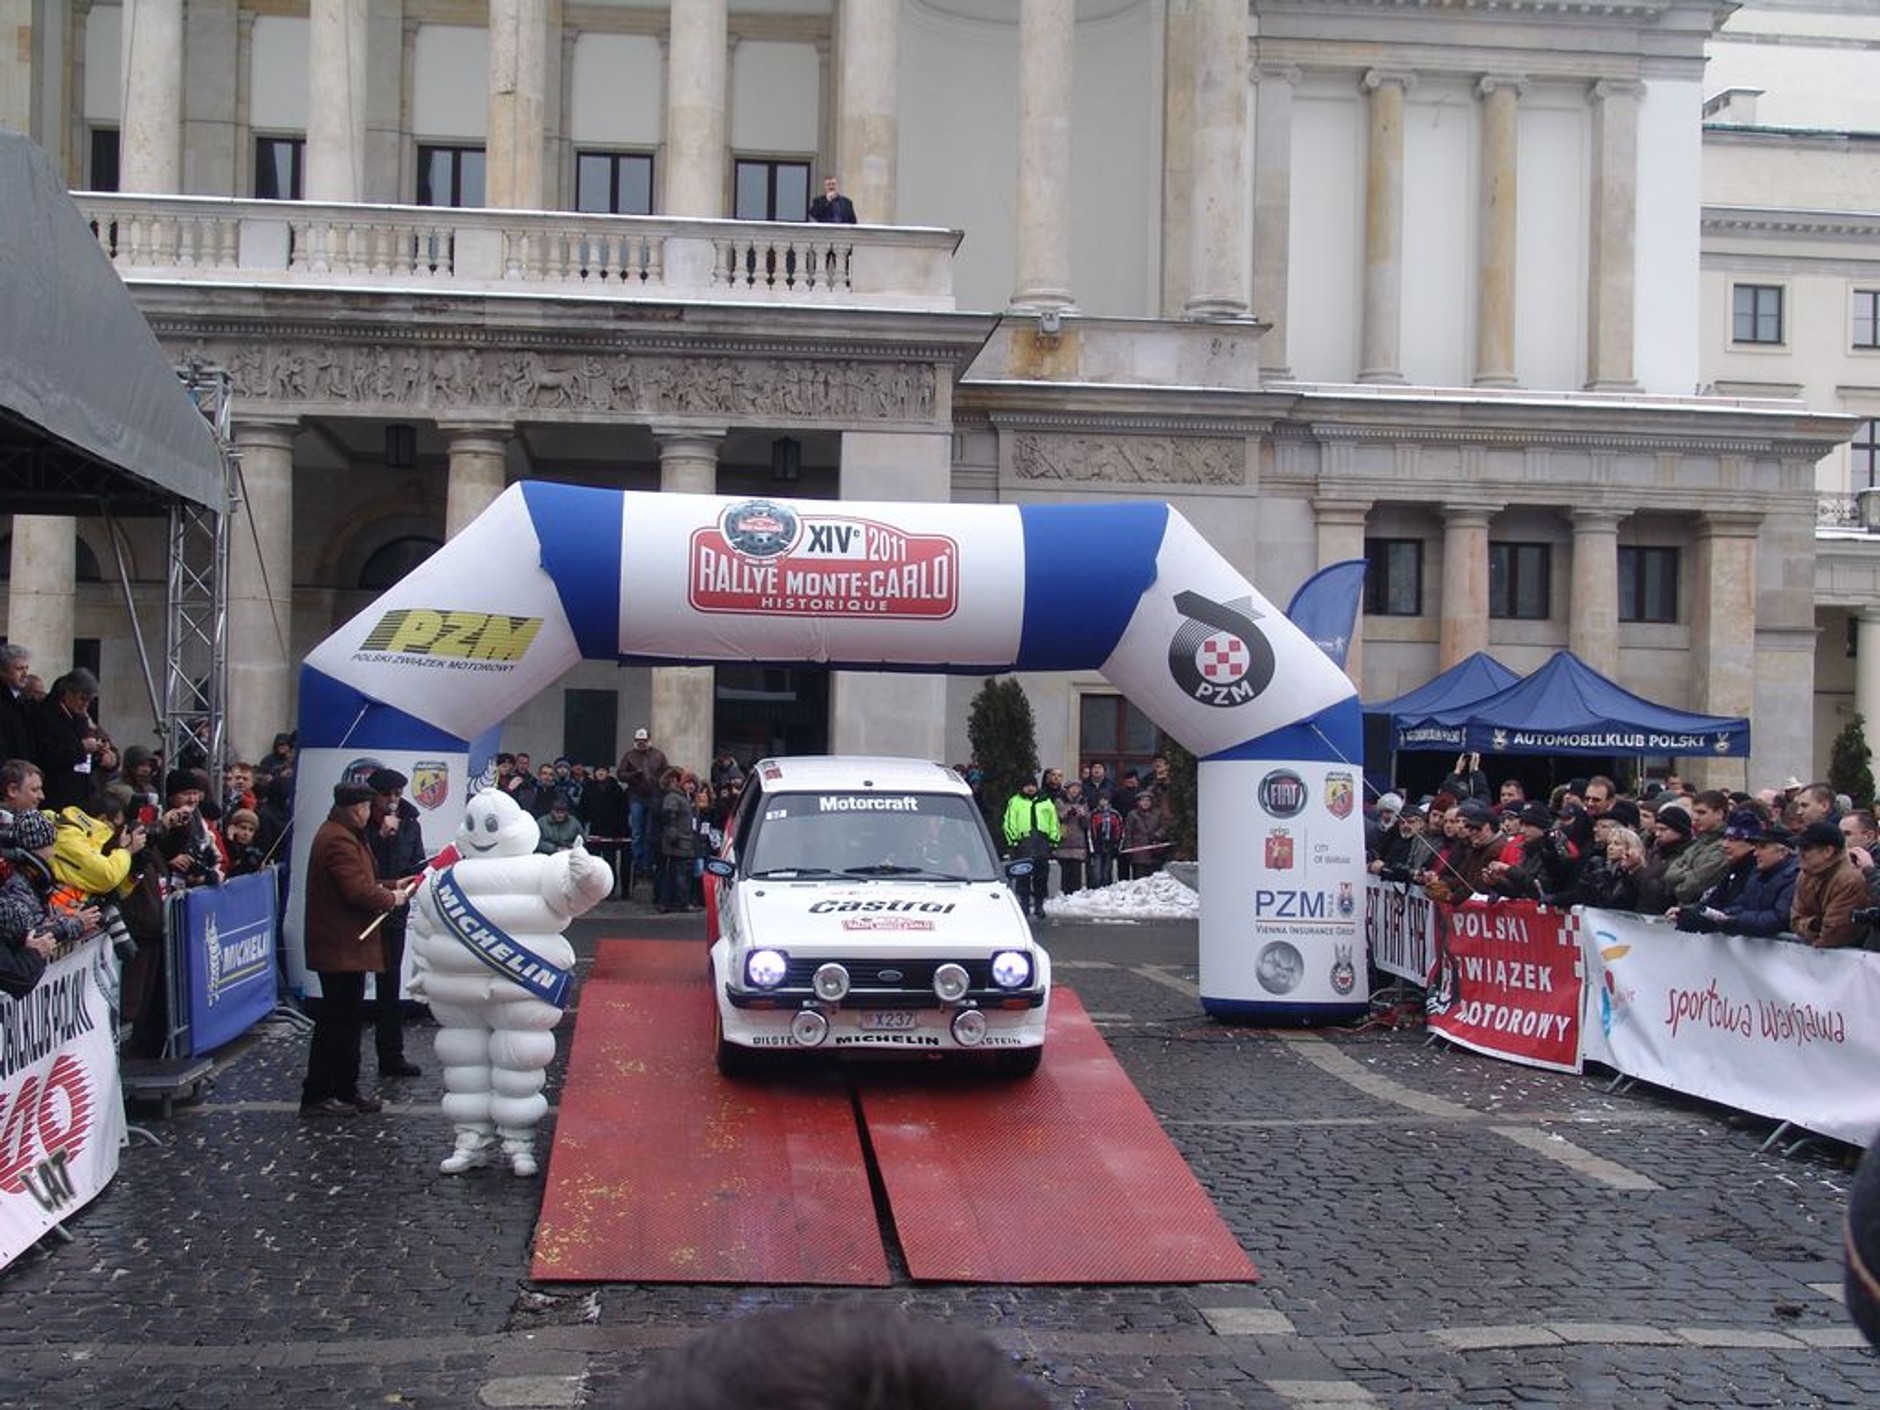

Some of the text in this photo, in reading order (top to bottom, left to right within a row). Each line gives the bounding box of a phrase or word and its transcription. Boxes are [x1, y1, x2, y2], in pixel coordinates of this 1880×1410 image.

[869, 526, 907, 562] 2011
[700, 545, 948, 600] RALLYE MONTE-CARLO
[762, 597, 888, 612] HISTORIQUE
[386, 608, 544, 661] PZM
[352, 653, 391, 664] POLSKI
[1195, 679, 1254, 704] PZM
[1514, 731, 1705, 748] AUTOMOBILKLUB POLSKI
[819, 796, 918, 812] Motorcraft
[1270, 783, 1298, 805] FIAT
[808, 899, 956, 914] Castrol
[1255, 890, 1325, 918] PZM
[438, 884, 557, 989] MICHELIN
[1452, 912, 1529, 944] POLSKI
[875, 1012, 914, 1026] X237
[1665, 978, 1752, 1038] sportowa
[835, 1035, 939, 1046] MICHELIN
[18, 1149, 77, 1215] LAT
